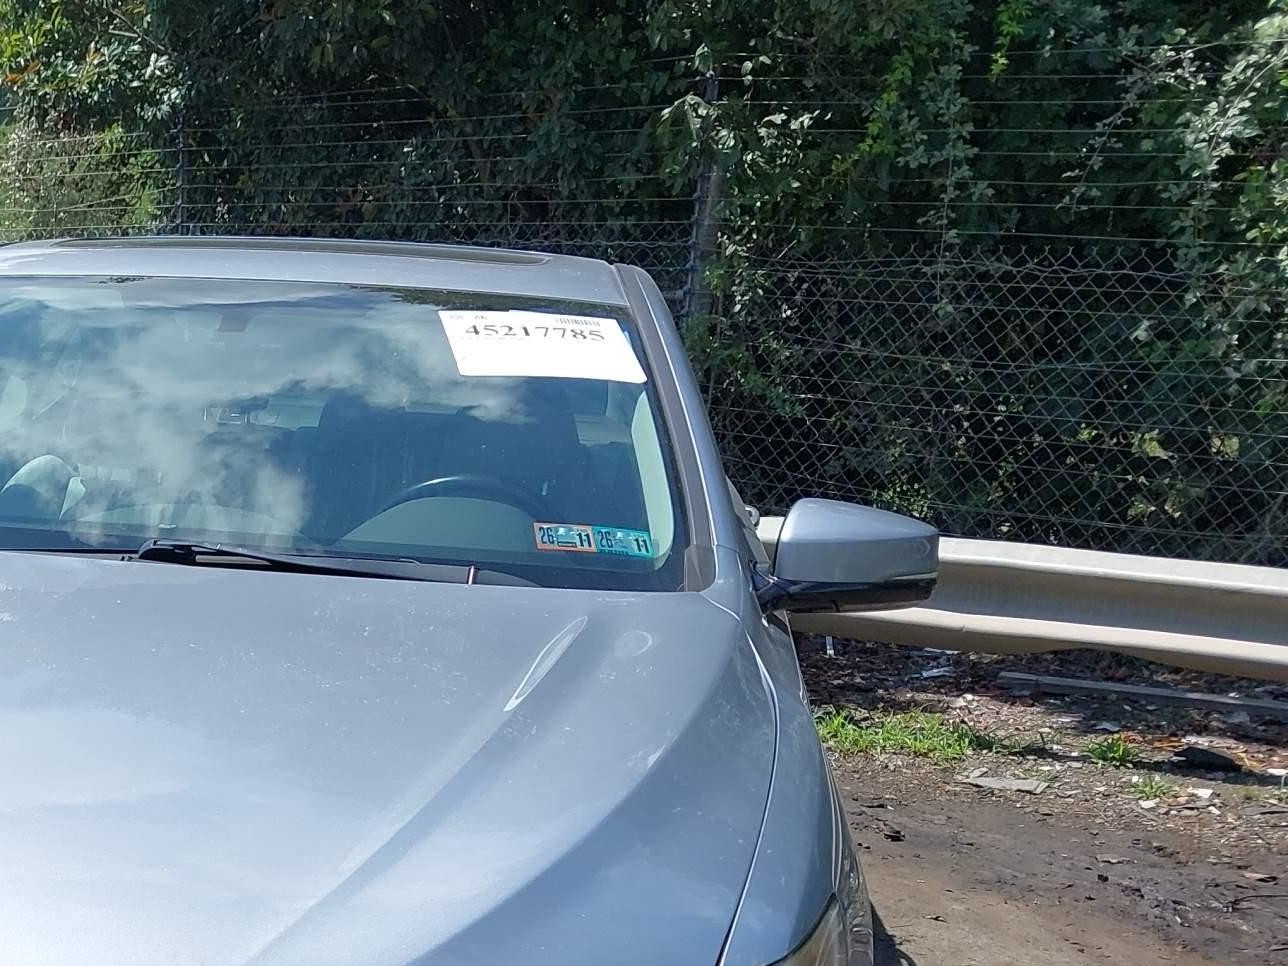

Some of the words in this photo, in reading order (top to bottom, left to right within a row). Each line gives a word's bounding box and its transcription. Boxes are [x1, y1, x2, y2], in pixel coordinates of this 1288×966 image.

[465, 324, 605, 342] 45217785
[538, 526, 555, 544] 26
[576, 532, 593, 548] 11
[597, 529, 614, 549] 26
[634, 537, 650, 554] 11
